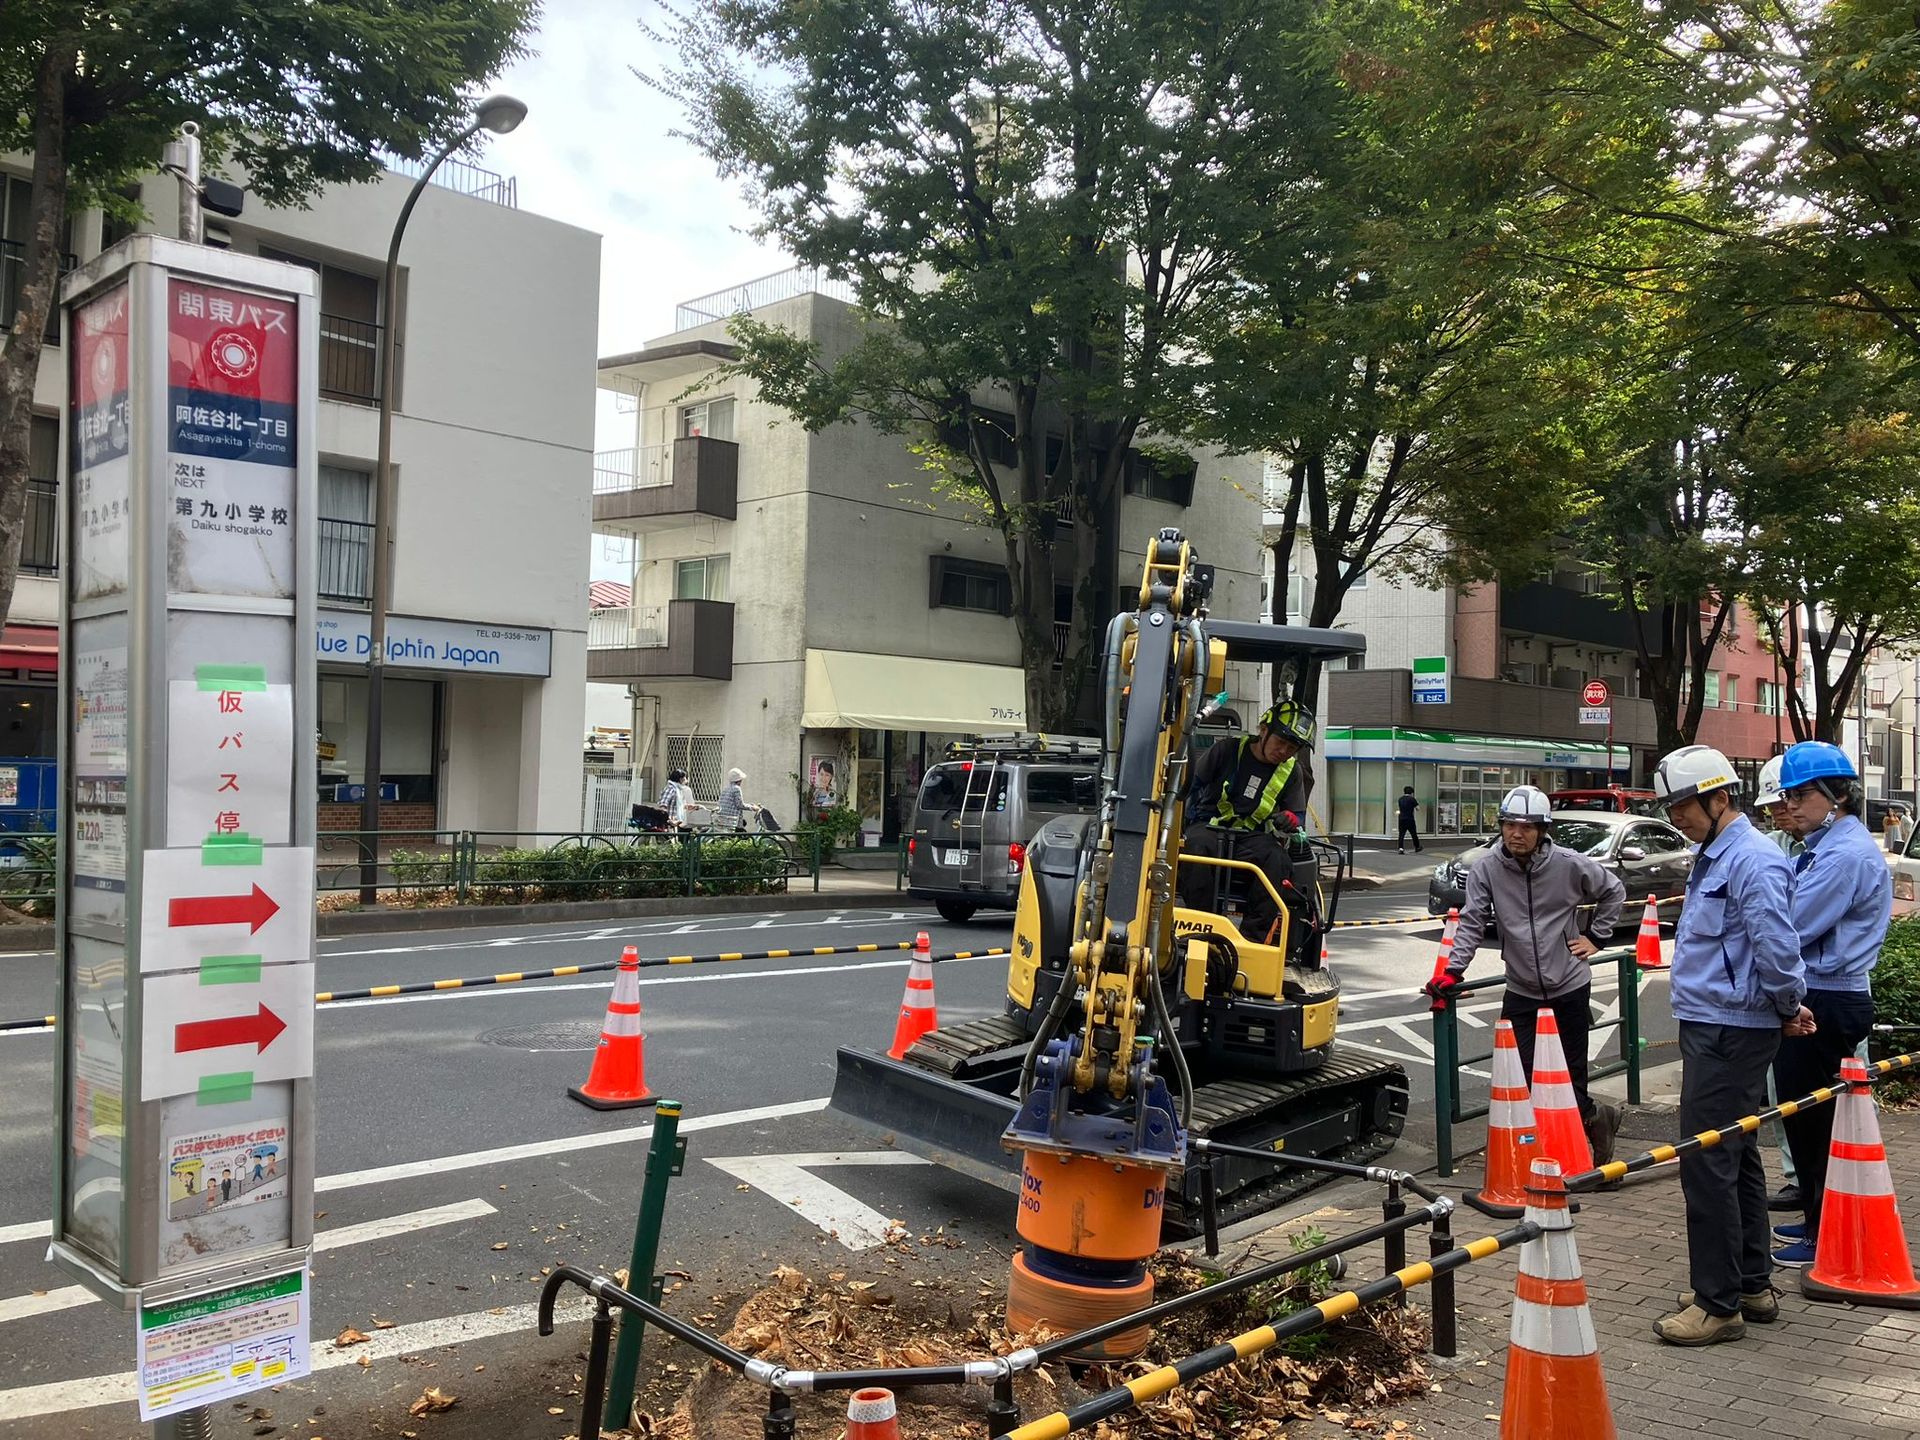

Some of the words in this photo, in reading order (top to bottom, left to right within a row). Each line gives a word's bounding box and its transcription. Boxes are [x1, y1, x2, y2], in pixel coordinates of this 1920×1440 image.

[178, 290, 287, 334] 関東バス
[176, 404, 287, 437] 阿佐谷北一丁目
[178, 429, 243, 447] Asagaya-kita
[247, 437, 286, 453] 1-chome
[174, 477, 205, 489] NEXT
[175, 463, 205, 477] 次は
[176, 496, 288, 525] 第九小学校
[191, 519, 221, 531] Daiku
[225, 524, 273, 536] shogakko
[316, 631, 348, 652] lue
[356, 635, 435, 661] Dlphin
[441, 641, 499, 667] Japan
[1414, 677, 1445, 685] FamilyMart
[215, 689, 243, 835] 仮バス停
[1553, 752, 1578, 763] FamilyMart
[172, 1127, 286, 1156] バス停でお待ちください
